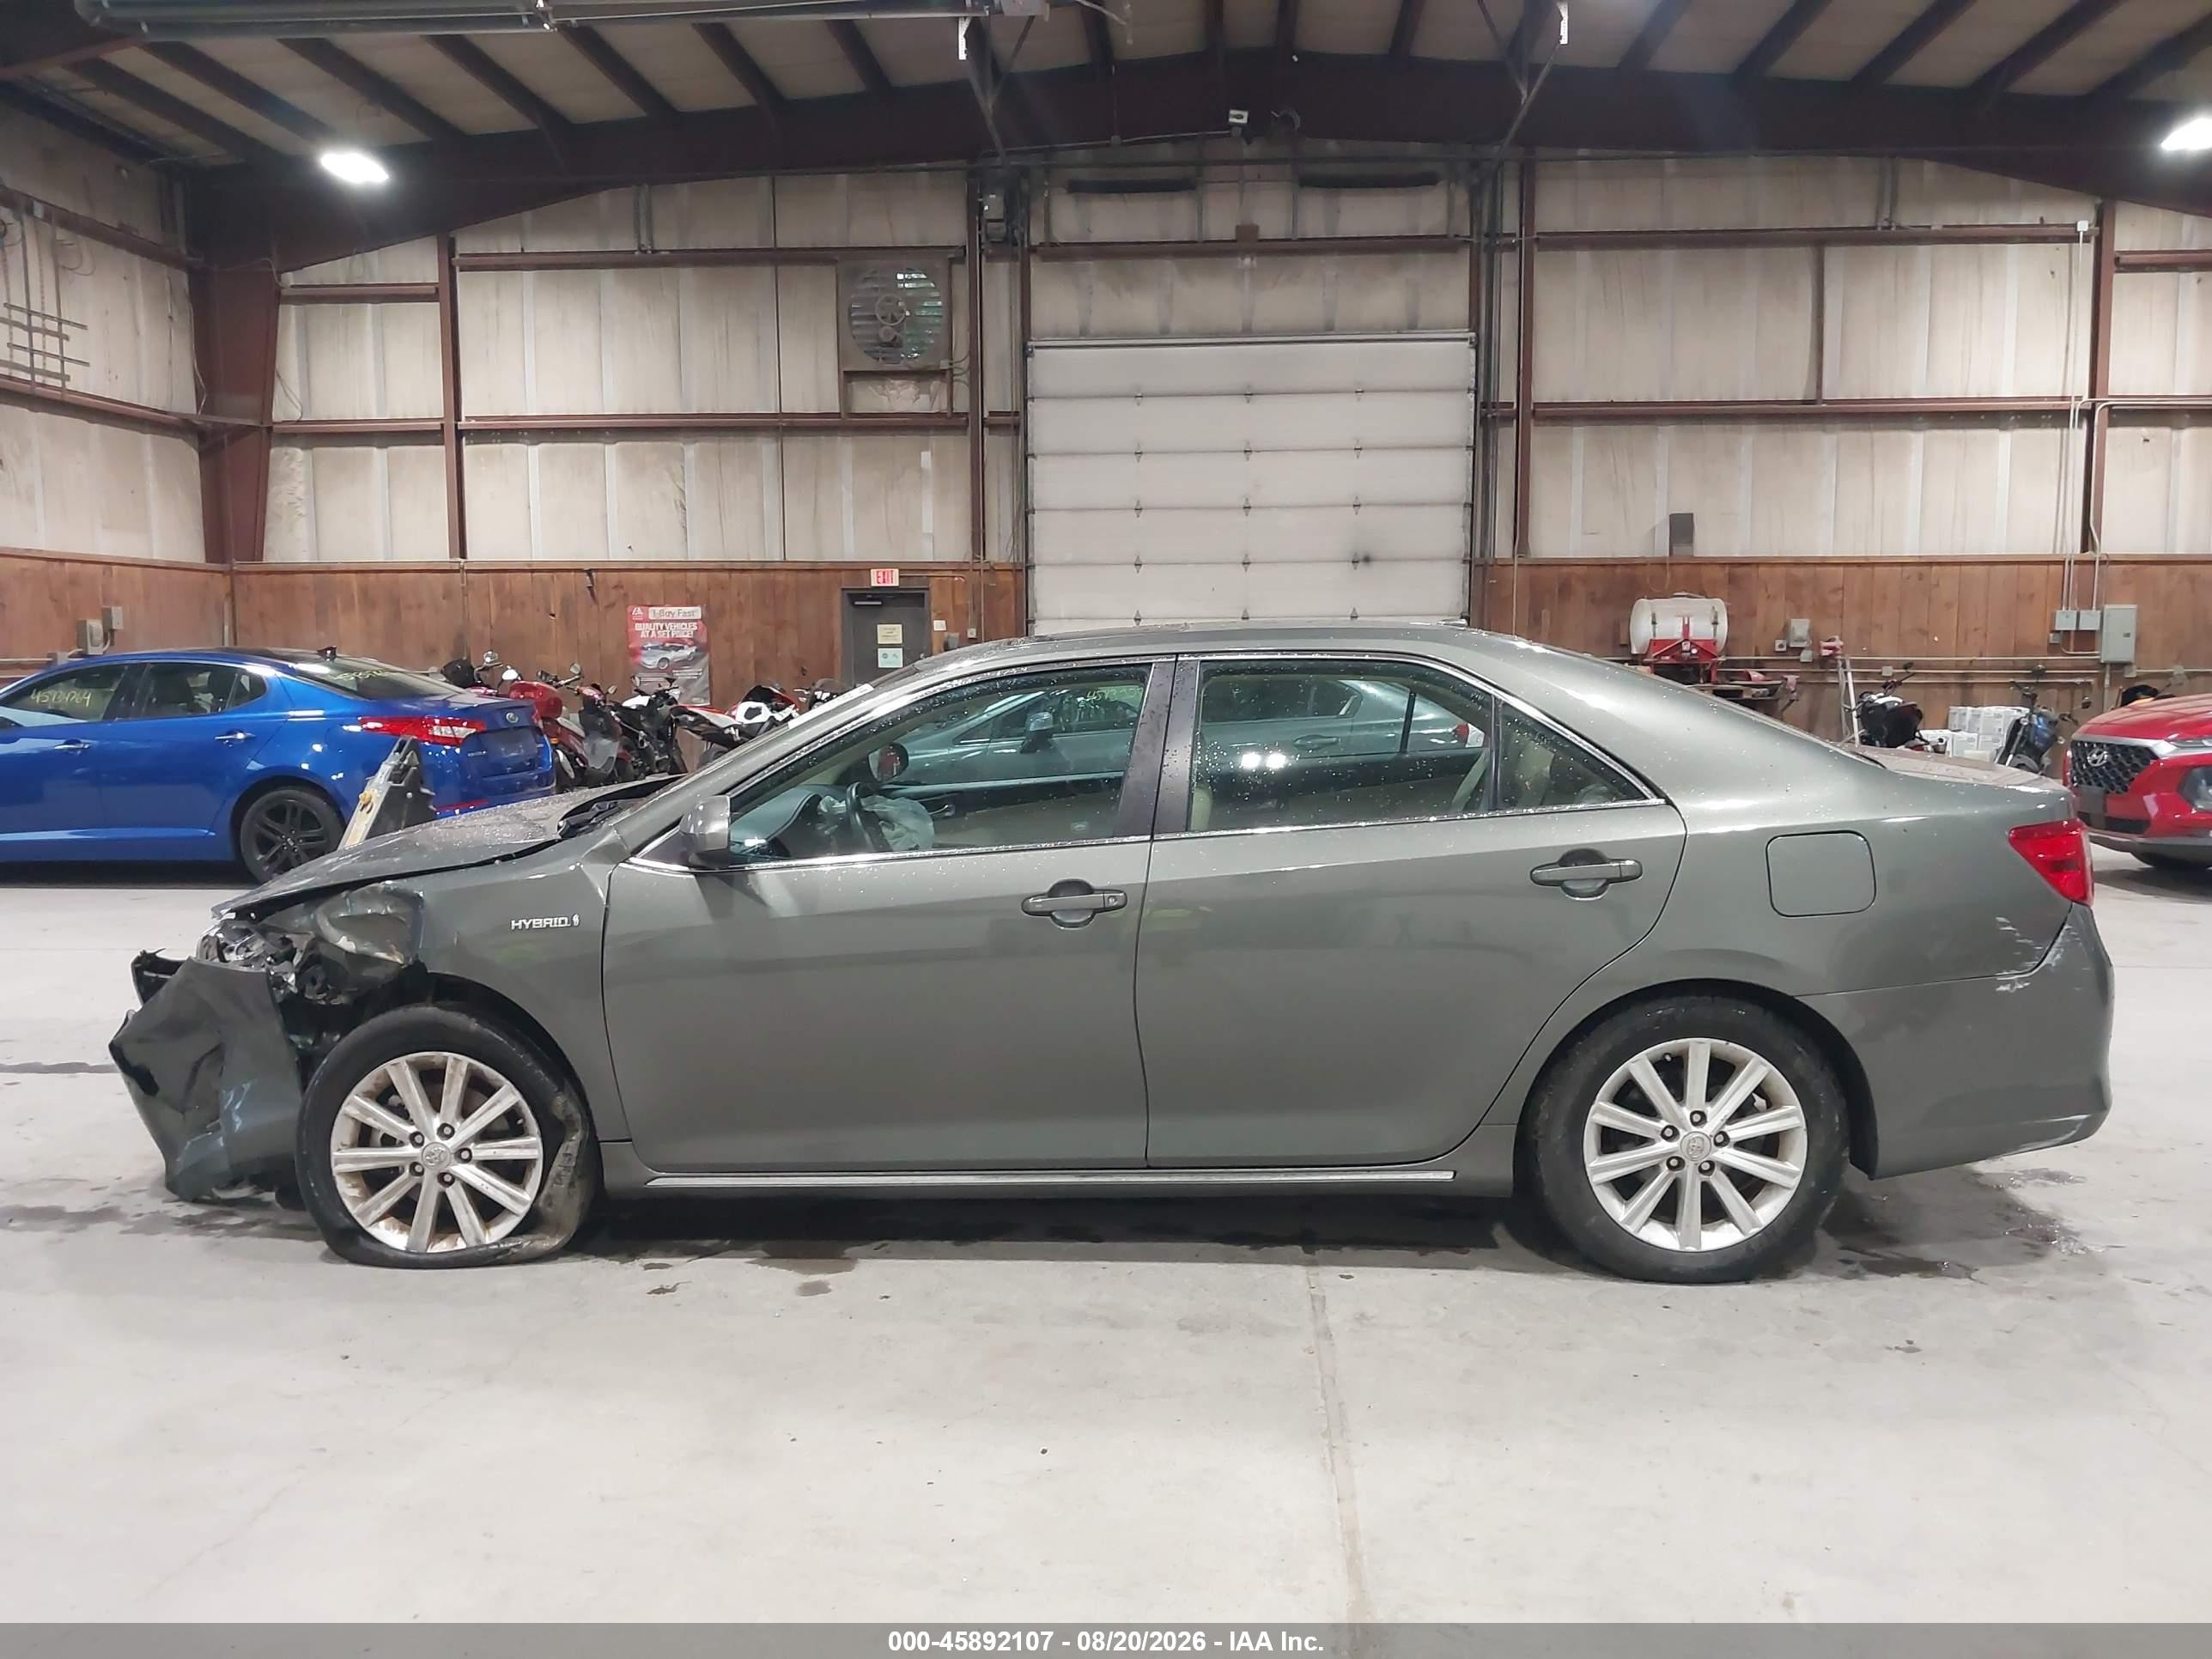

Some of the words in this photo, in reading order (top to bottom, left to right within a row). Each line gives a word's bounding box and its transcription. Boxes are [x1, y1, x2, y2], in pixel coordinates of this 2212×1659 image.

[876, 569, 894, 584] EXIT
[678, 608, 695, 617] Fast
[635, 622, 664, 631] QUALITY
[665, 622, 698, 630] VEHICLES
[511, 916, 571, 930] HYBRID
